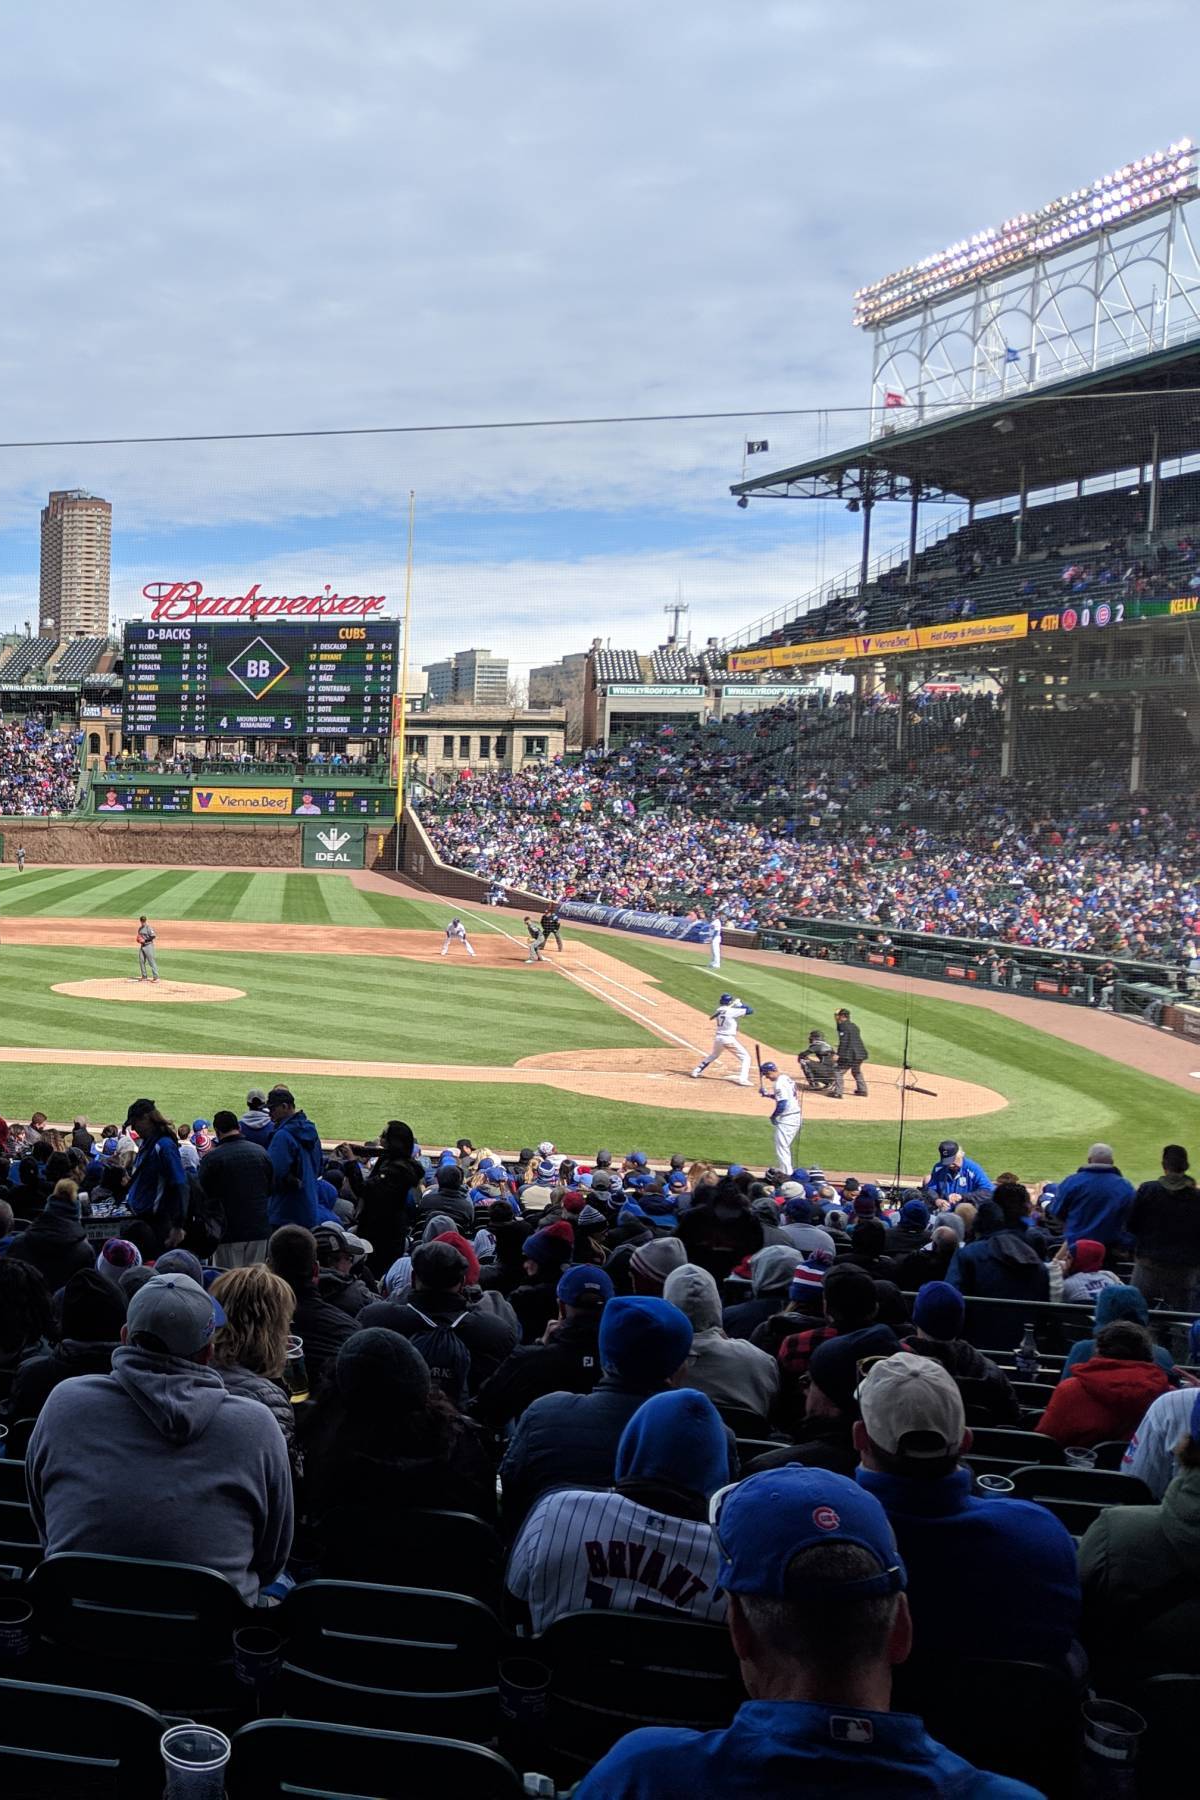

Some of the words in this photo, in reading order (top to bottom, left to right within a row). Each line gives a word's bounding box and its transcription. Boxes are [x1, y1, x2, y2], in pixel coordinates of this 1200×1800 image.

[143, 581, 386, 621] Budweiser
[1170, 597, 1199, 616] KELLY
[1040, 614, 1059, 631] 4TH
[1081, 608, 1090, 627] 0
[1115, 604, 1125, 622] 2
[147, 628, 191, 640] D-BACKS
[338, 627, 367, 639] CUBS
[931, 631, 942, 641] Hot
[943, 631, 958, 641] Dogs
[987, 623, 1015, 635] Sausage
[247, 660, 270, 678] BB
[612, 686, 700, 695] WRIGLEYROOFTOPS.COM
[220, 716, 228, 728] 4
[284, 717, 292, 729] 5
[219, 795, 260, 807] Vienna
[262, 796, 289, 810] Beef
[315, 852, 351, 862] IDEAL
[618, 912, 655, 929] Reynolds
[654, 917, 680, 932] Wrap
[585, 1540, 708, 1608] BRYANT
